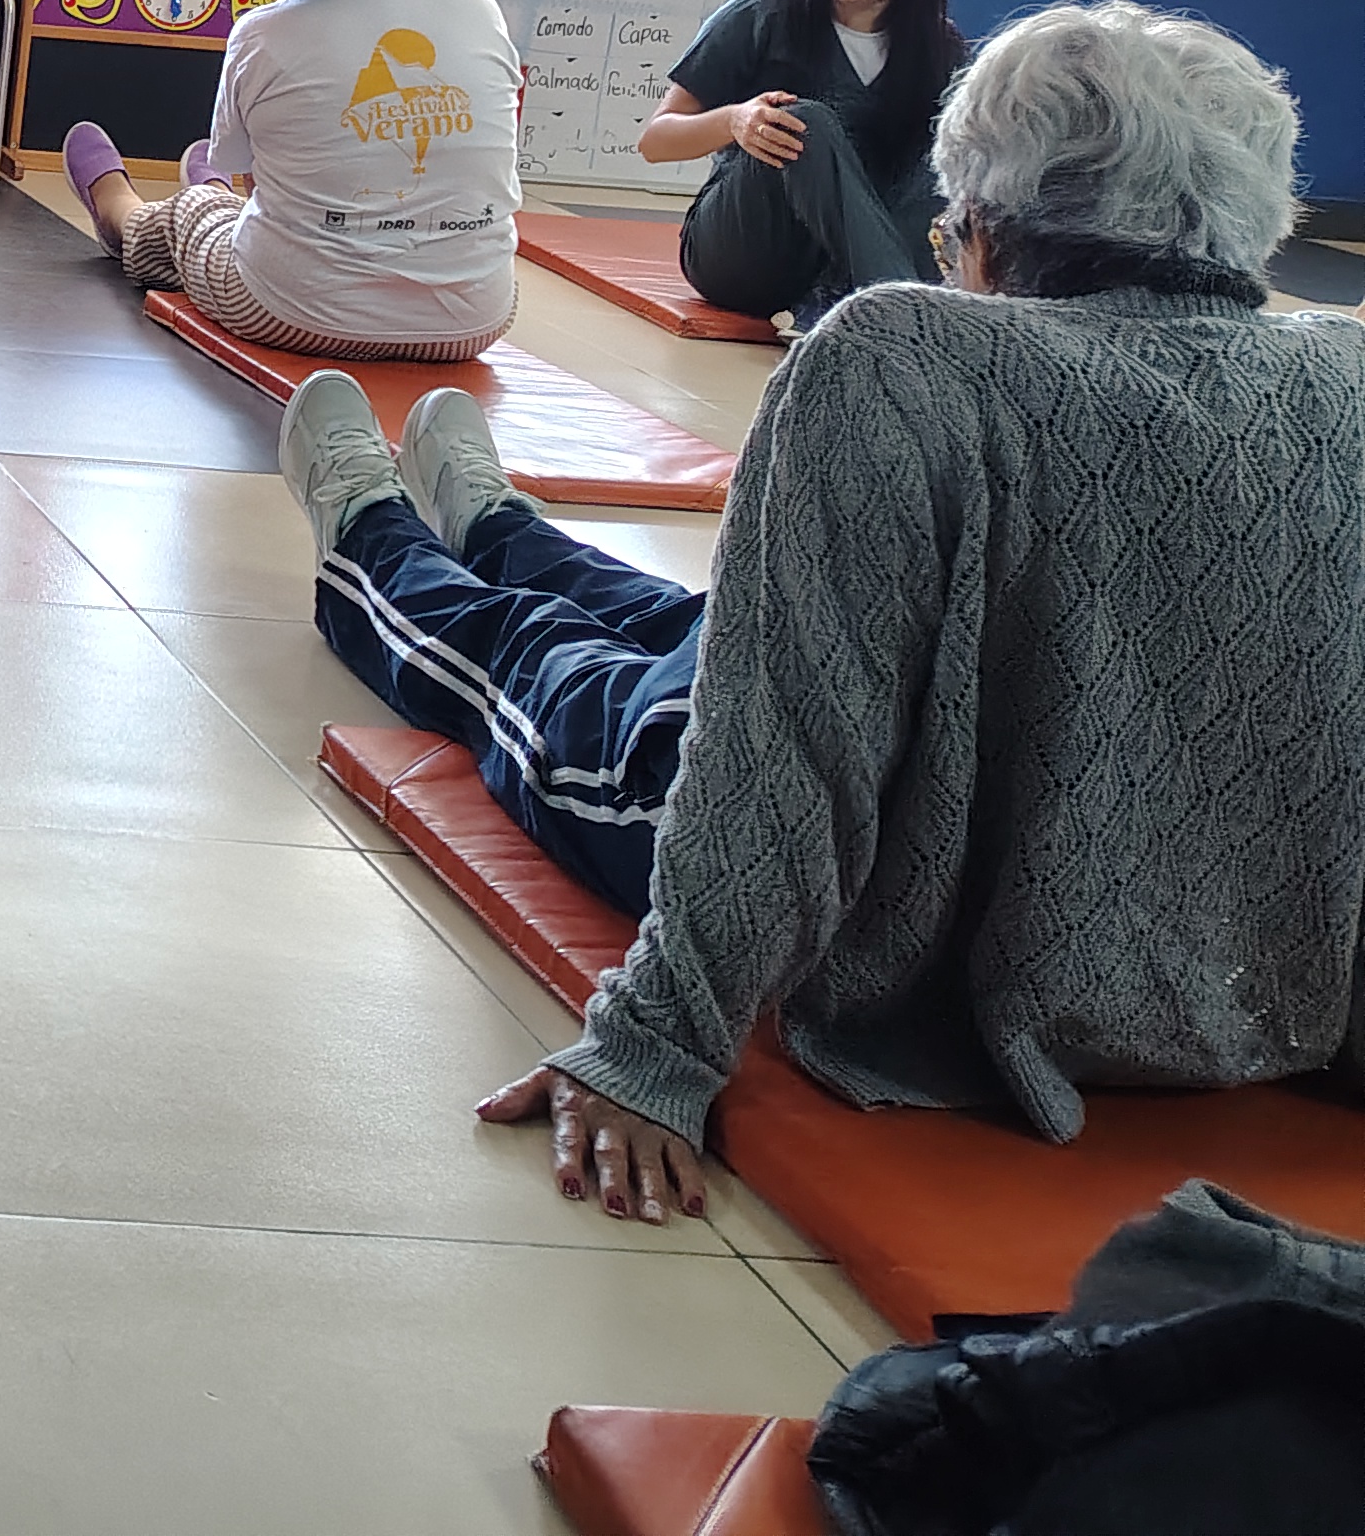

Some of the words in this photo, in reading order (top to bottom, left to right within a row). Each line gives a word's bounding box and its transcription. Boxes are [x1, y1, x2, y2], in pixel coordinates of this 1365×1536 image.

[155, 8, 162, 17] 7
[619, 20, 672, 46] Capaz
[527, 66, 599, 92] Calmado
[370, 92, 456, 120] Festival
[341, 108, 473, 143] Verano
[377, 219, 416, 231] IDRD
